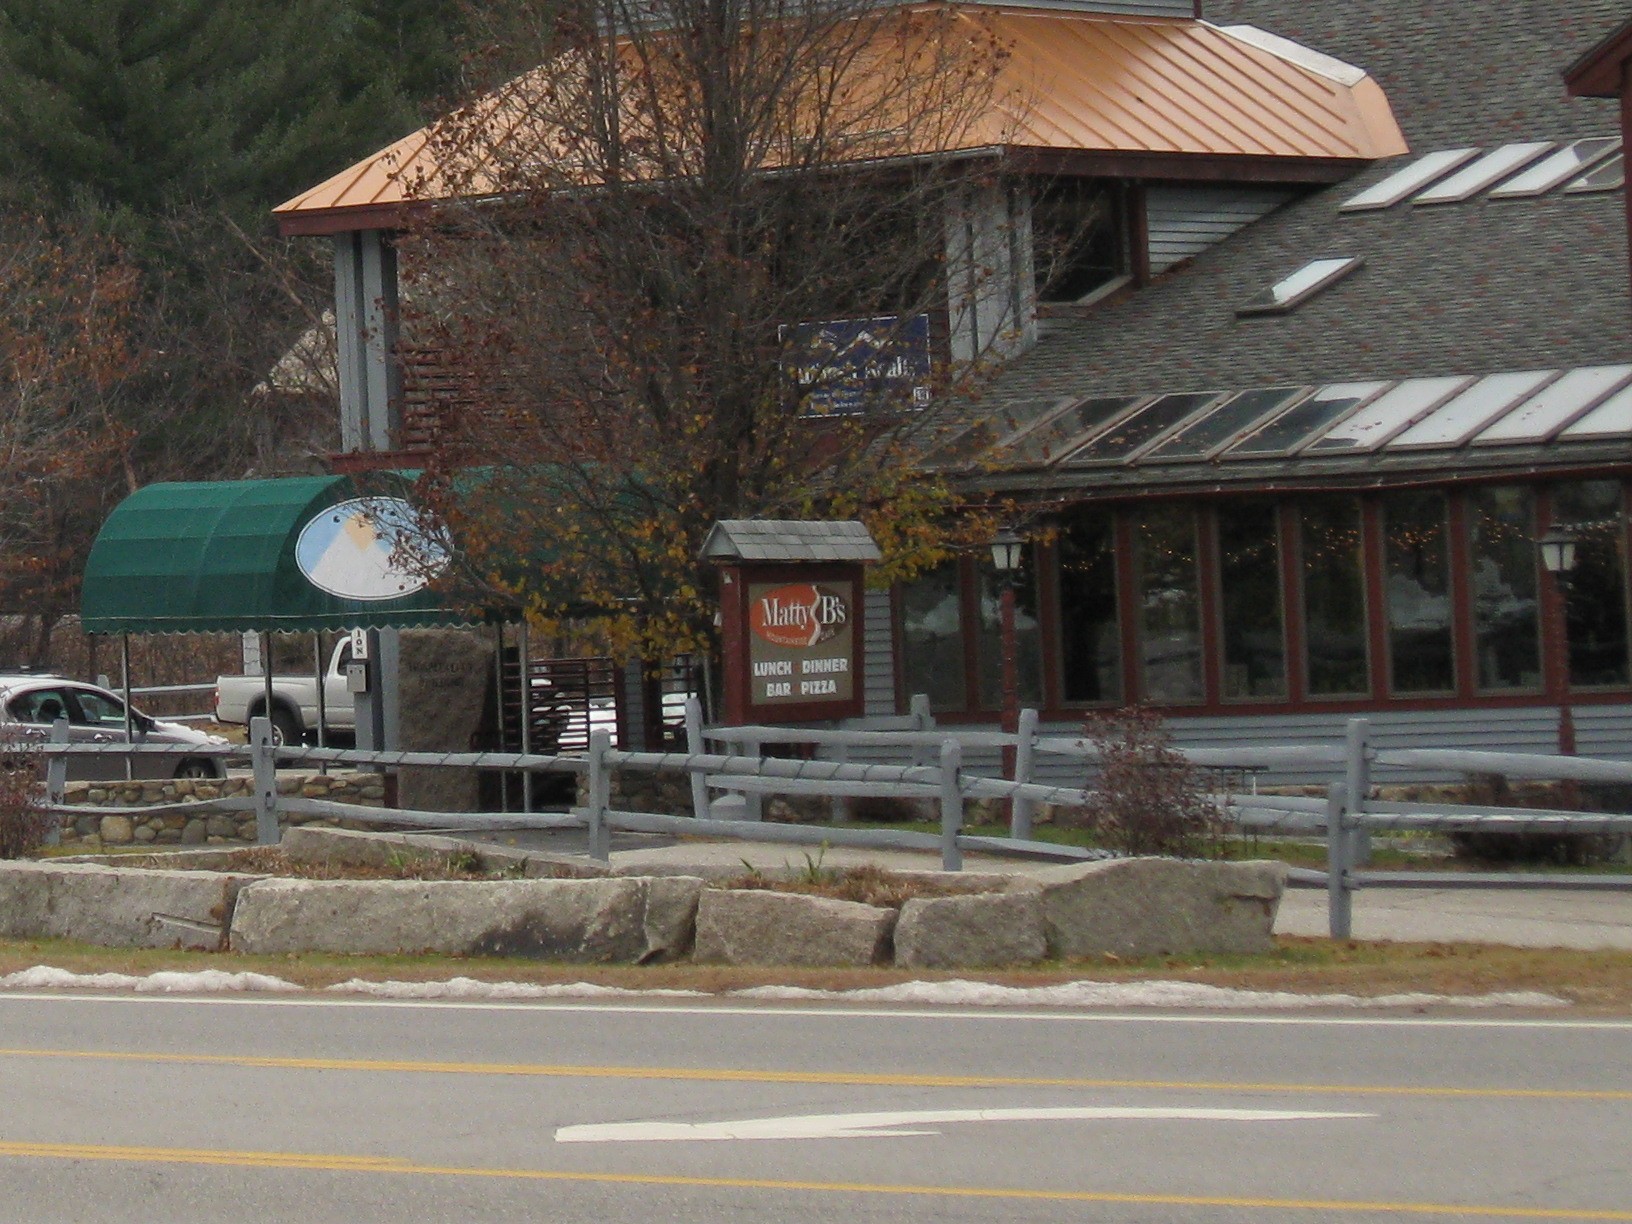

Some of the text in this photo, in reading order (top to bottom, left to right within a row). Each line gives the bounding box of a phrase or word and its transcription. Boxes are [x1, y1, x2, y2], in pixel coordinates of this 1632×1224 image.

[761, 596, 846, 629] Matty B's
[754, 658, 848, 676] LUNCH DINNER
[766, 680, 837, 696] BAR PIZZA
